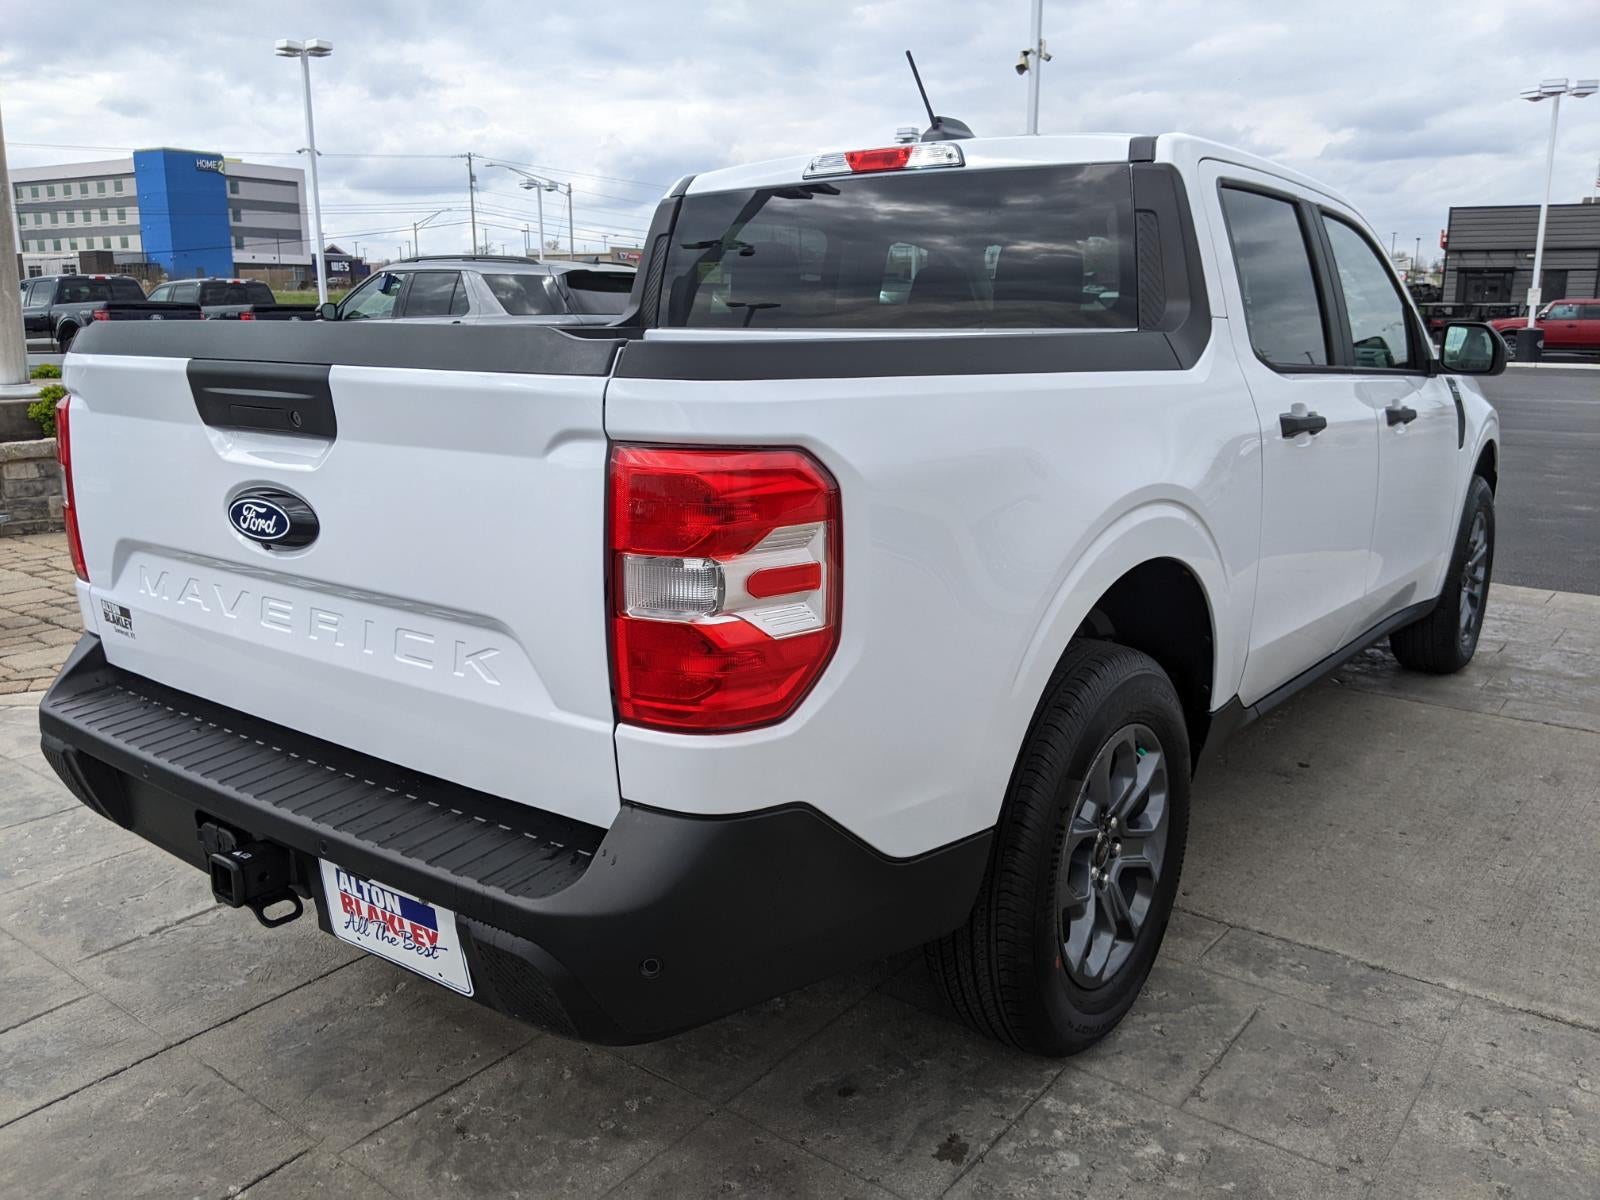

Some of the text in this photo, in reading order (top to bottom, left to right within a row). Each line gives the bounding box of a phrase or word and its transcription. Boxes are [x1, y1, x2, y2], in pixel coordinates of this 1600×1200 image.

[240, 503, 277, 534] Ford
[138, 564, 502, 687] MAVERICK
[338, 871, 402, 917] ALTON
[340, 892, 439, 947] BLAKLEY
[344, 911, 448, 960] All The Best
